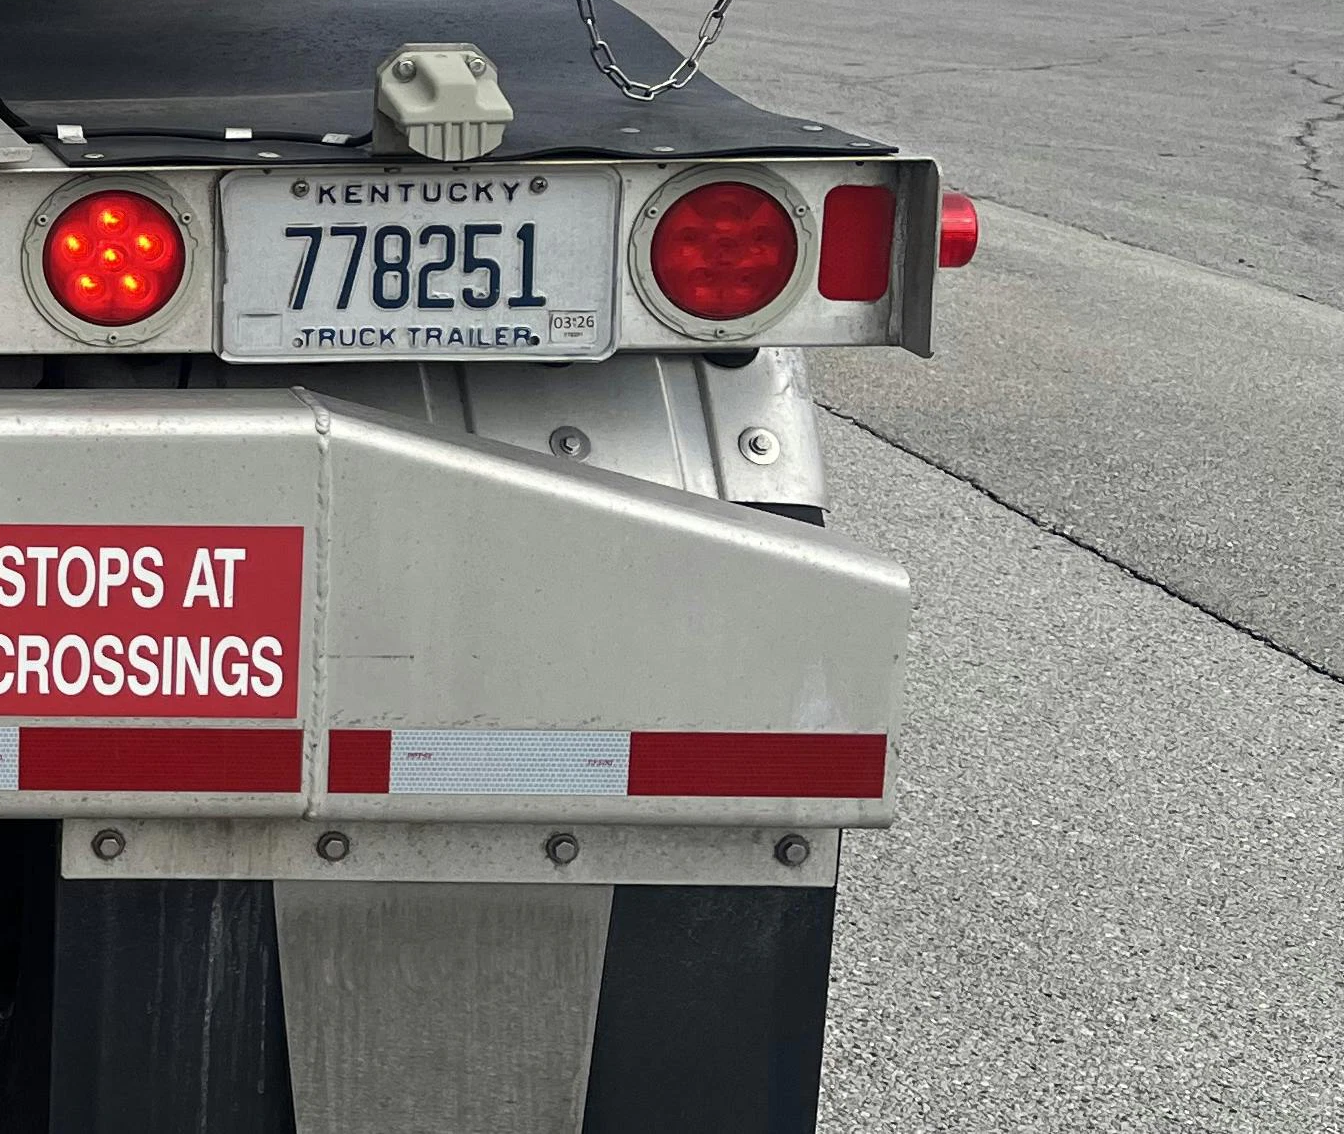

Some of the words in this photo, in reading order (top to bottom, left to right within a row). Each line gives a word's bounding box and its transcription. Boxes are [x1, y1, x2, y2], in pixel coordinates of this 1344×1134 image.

[318, 182, 520, 204] KENTUCKY
[285, 223, 547, 310] 778251
[301, 327, 397, 347] TRUCK
[407, 326, 533, 347] TRAILER
[182, 547, 247, 608] AT
